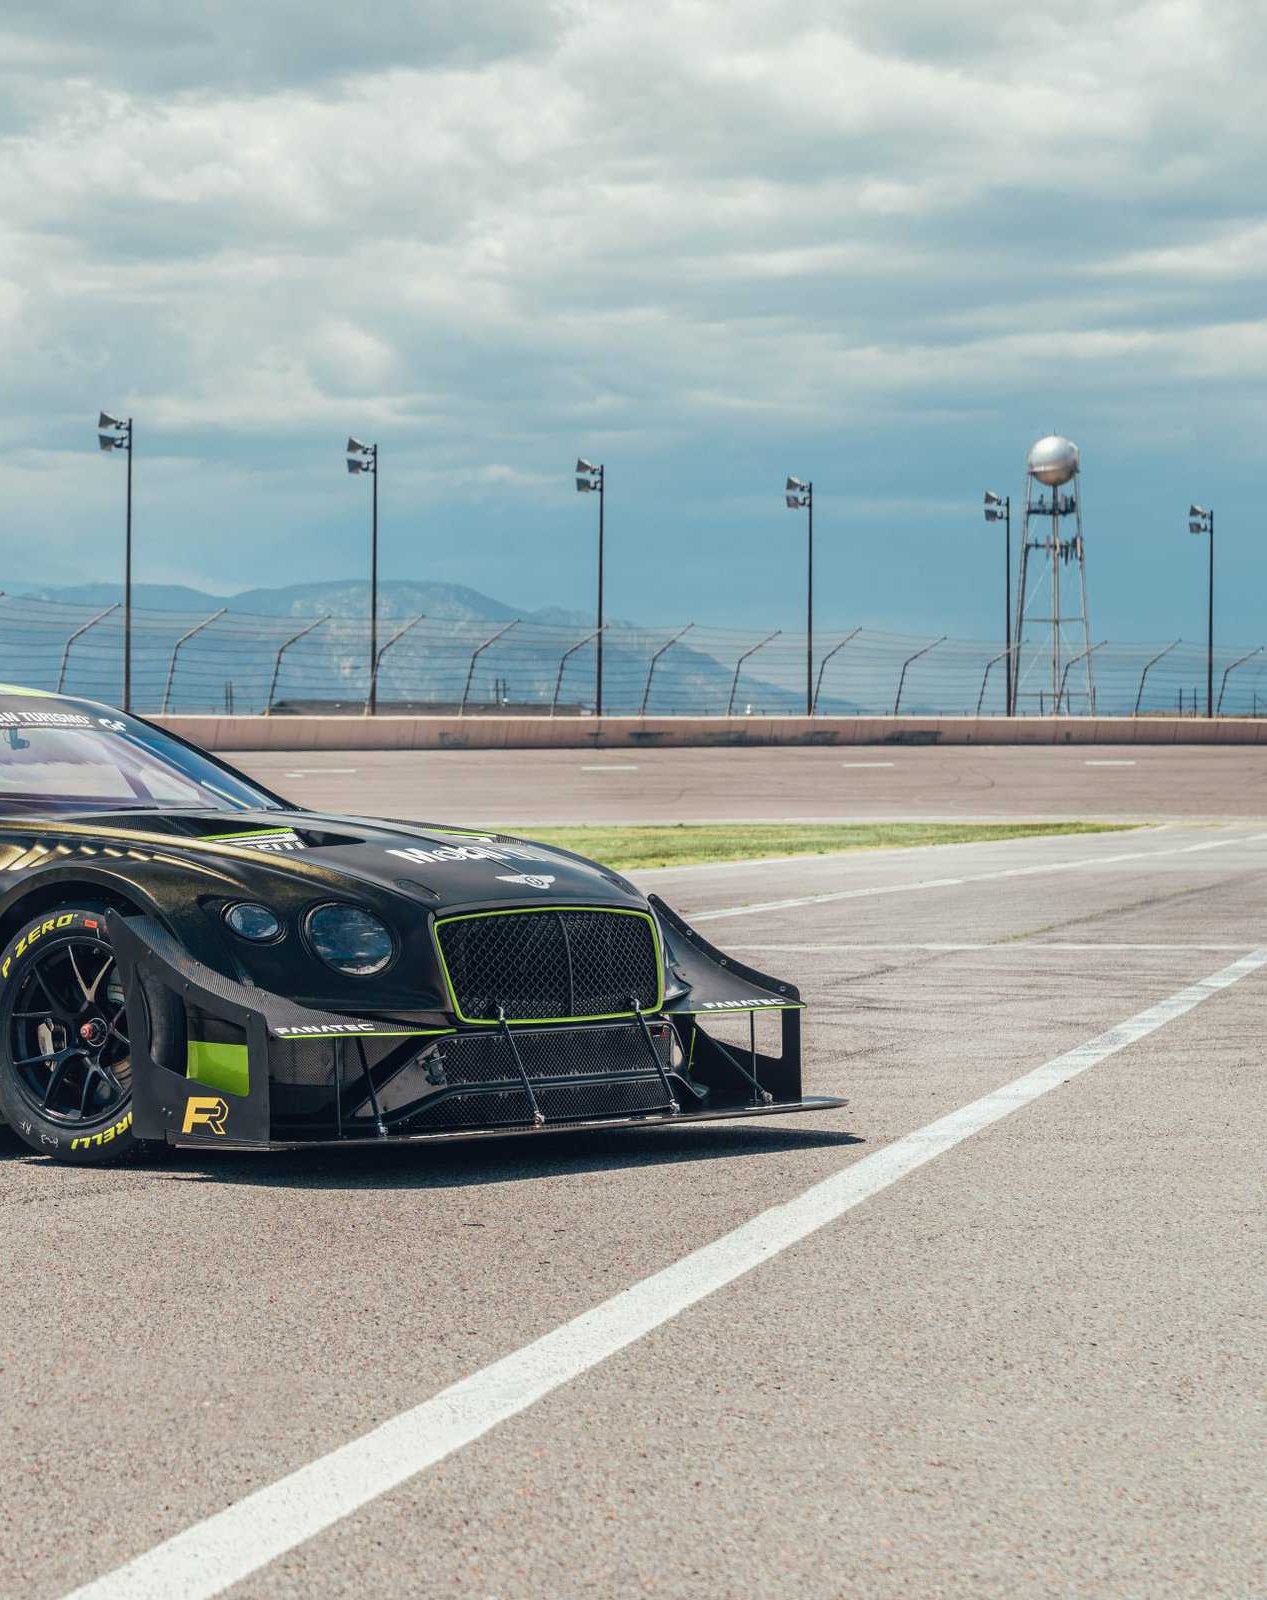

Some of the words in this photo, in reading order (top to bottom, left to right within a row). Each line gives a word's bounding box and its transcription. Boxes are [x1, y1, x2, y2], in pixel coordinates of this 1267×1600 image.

[18, 712, 90, 724] TURISMO
[2, 956, 11, 978] P
[15, 913, 74, 958] ZERO
[702, 998, 786, 1009] FANATEC
[274, 1023, 375, 1035] FANATEC
[70, 1111, 133, 1150] IRELLI
